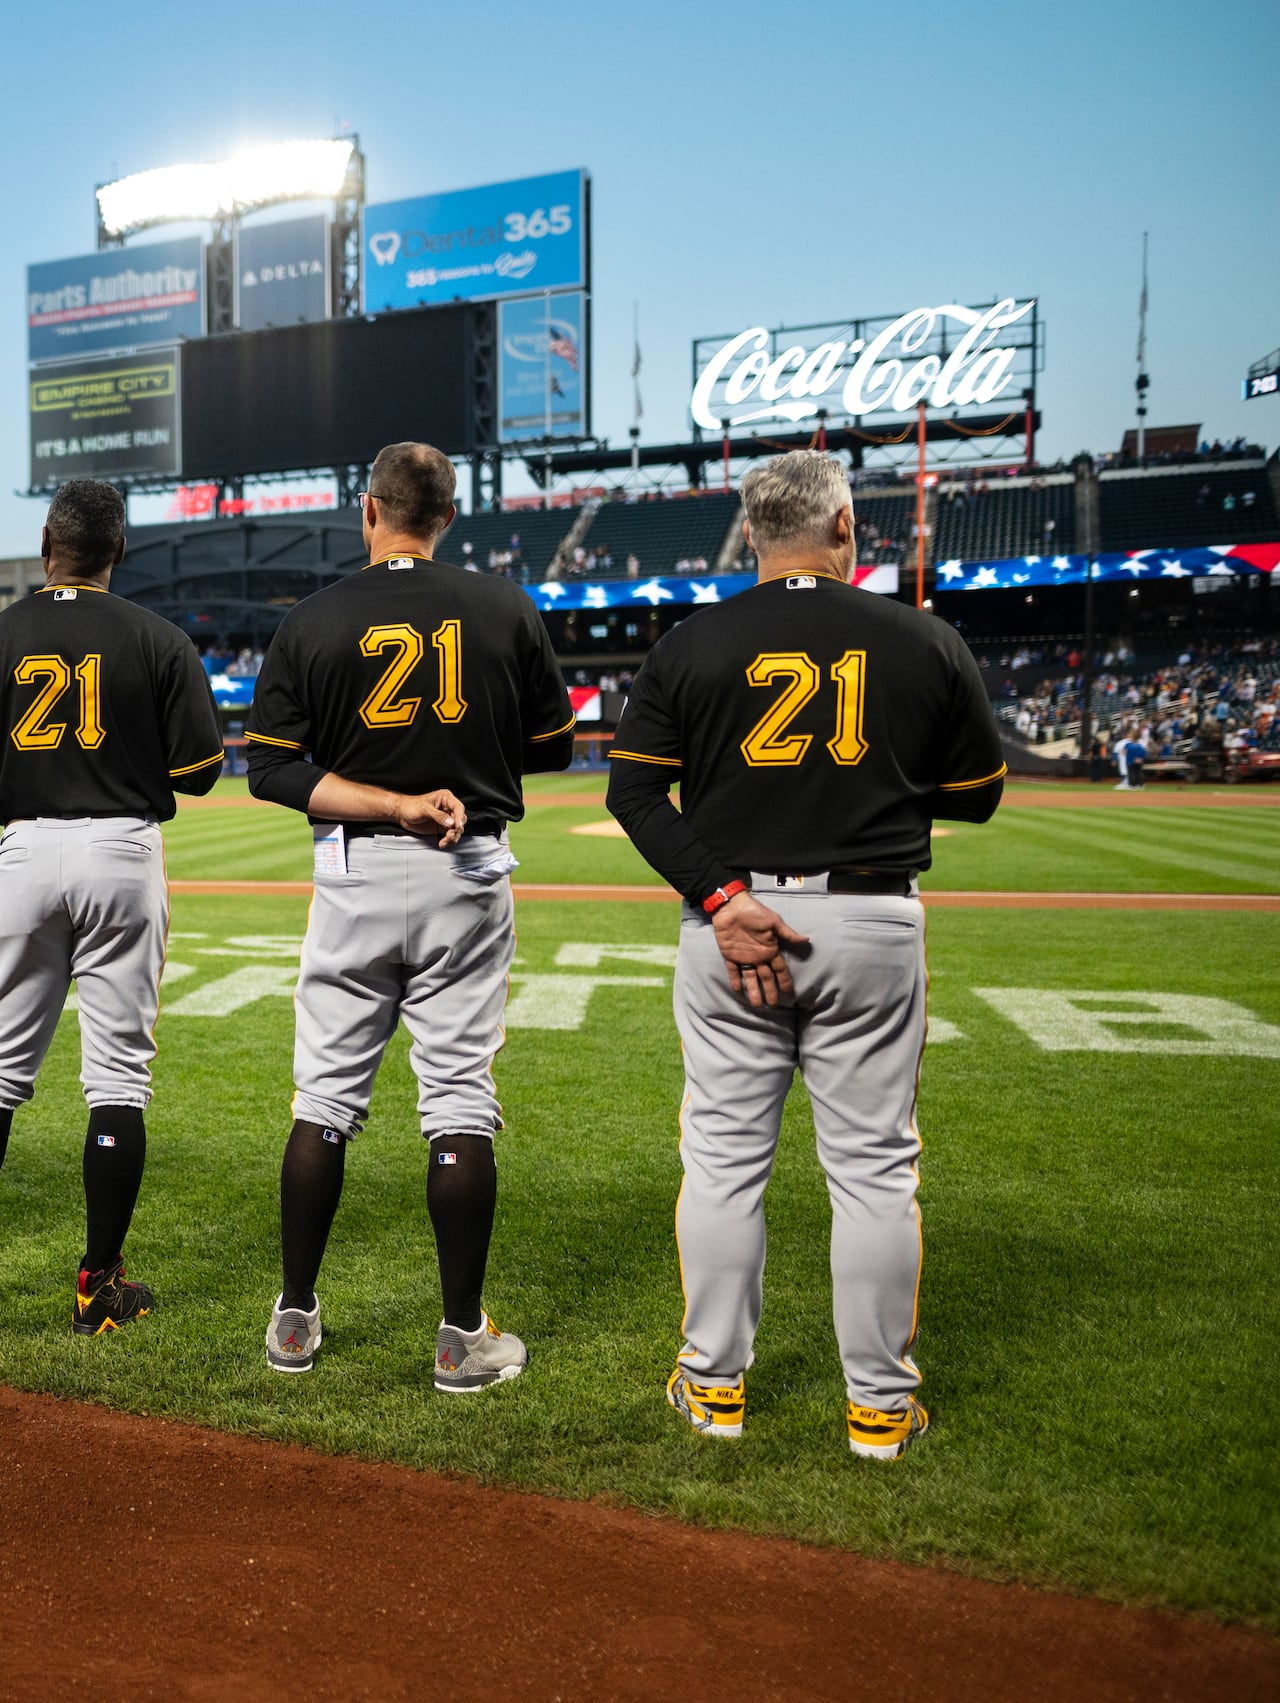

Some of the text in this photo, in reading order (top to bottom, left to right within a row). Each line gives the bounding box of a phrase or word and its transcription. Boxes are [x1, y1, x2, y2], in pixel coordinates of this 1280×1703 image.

[29, 284, 87, 316] Parts
[89, 265, 199, 304] Authority
[260, 258, 324, 284] DELTA
[690, 297, 1037, 431] Coca-Cola
[38, 374, 166, 402] EMPIRE CITY
[67, 439, 81, 455] A
[81, 431, 132, 453] HOME
[133, 428, 170, 447] RUN
[358, 619, 469, 729] 21
[10, 653, 107, 752] 21
[739, 649, 870, 767] 21
[716, 1389, 735, 1399] NIKE
[858, 1410, 879, 1421] NIKE
